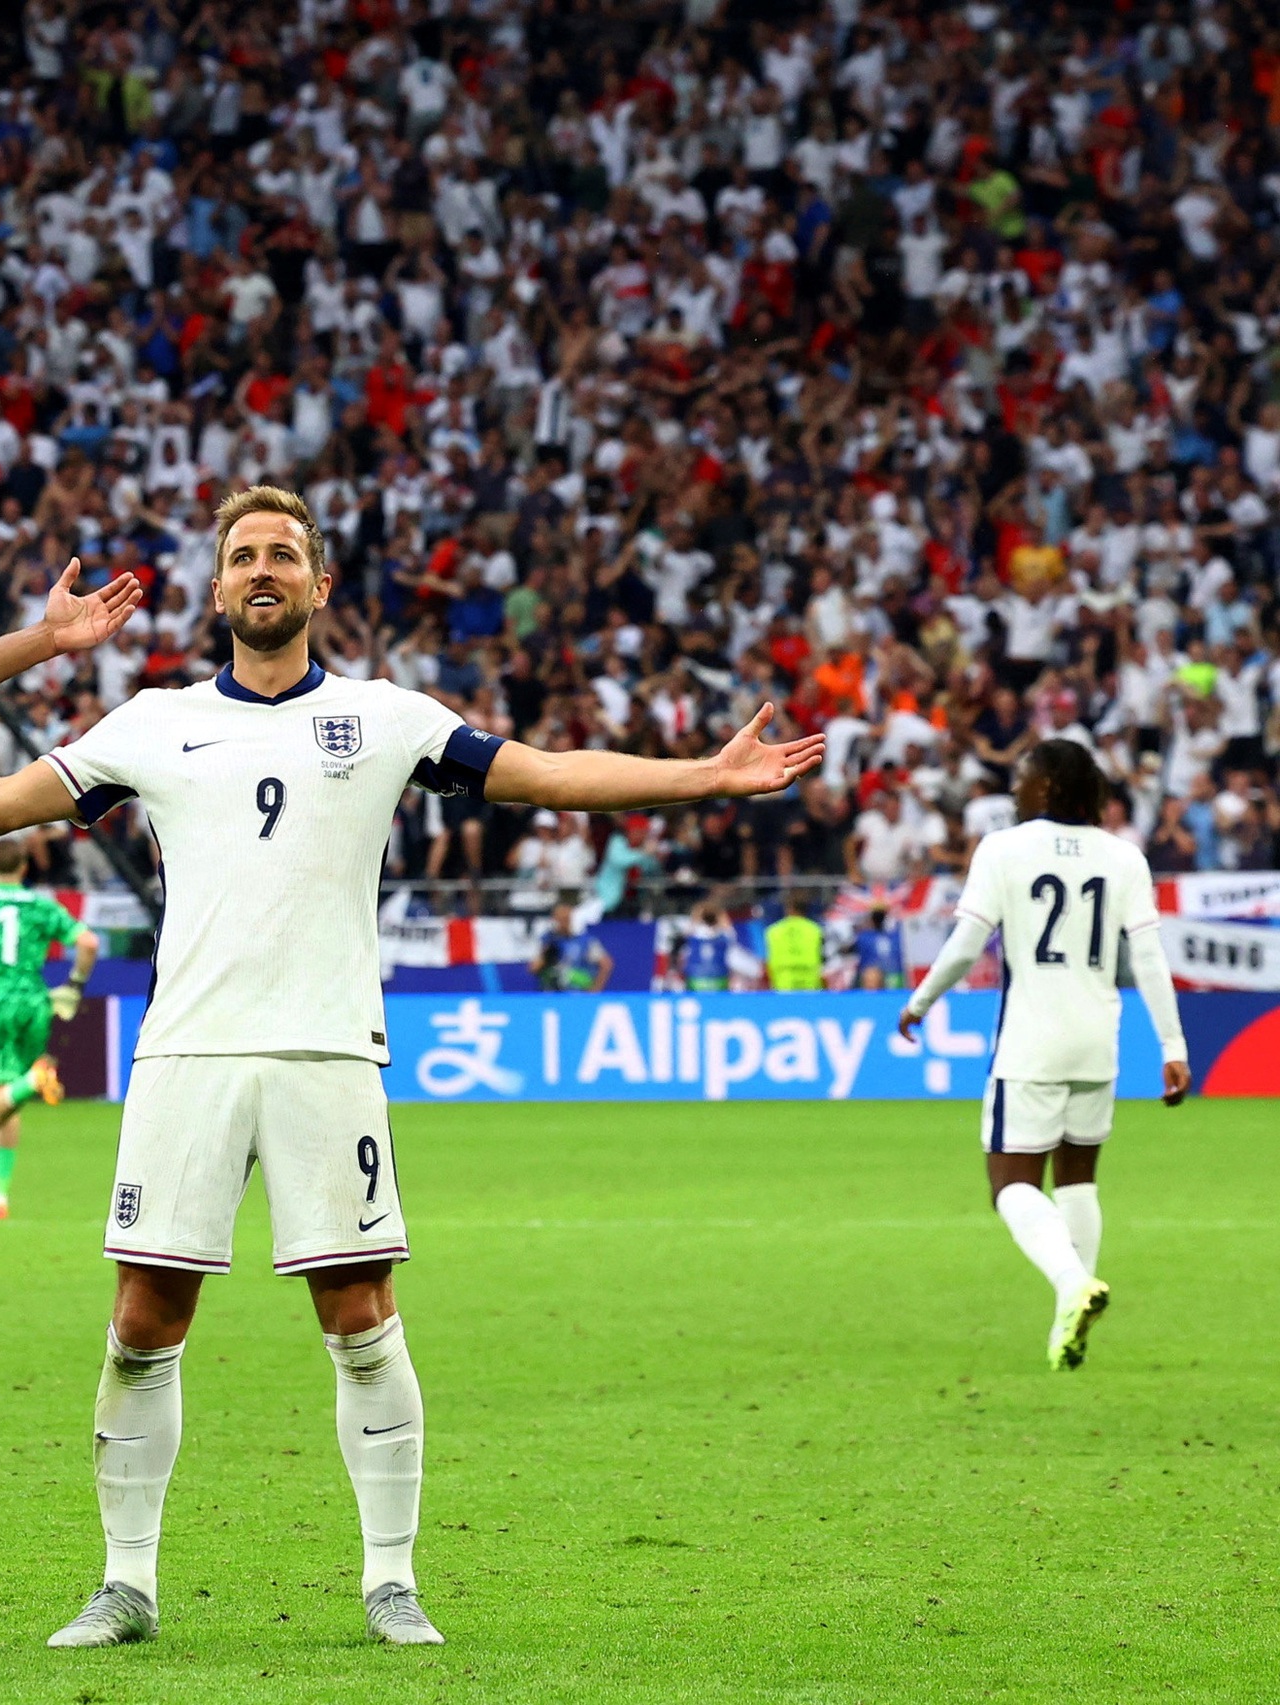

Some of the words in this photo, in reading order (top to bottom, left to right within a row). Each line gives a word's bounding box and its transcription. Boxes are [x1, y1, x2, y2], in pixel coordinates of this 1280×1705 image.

[321, 760, 354, 770] SLOVAKIA
[256, 777, 287, 840] 9
[1055, 837, 1082, 857] EZE
[1031, 873, 1107, 971] 21
[576, 998, 875, 1099] Alipay
[357, 1135, 380, 1204] 9
